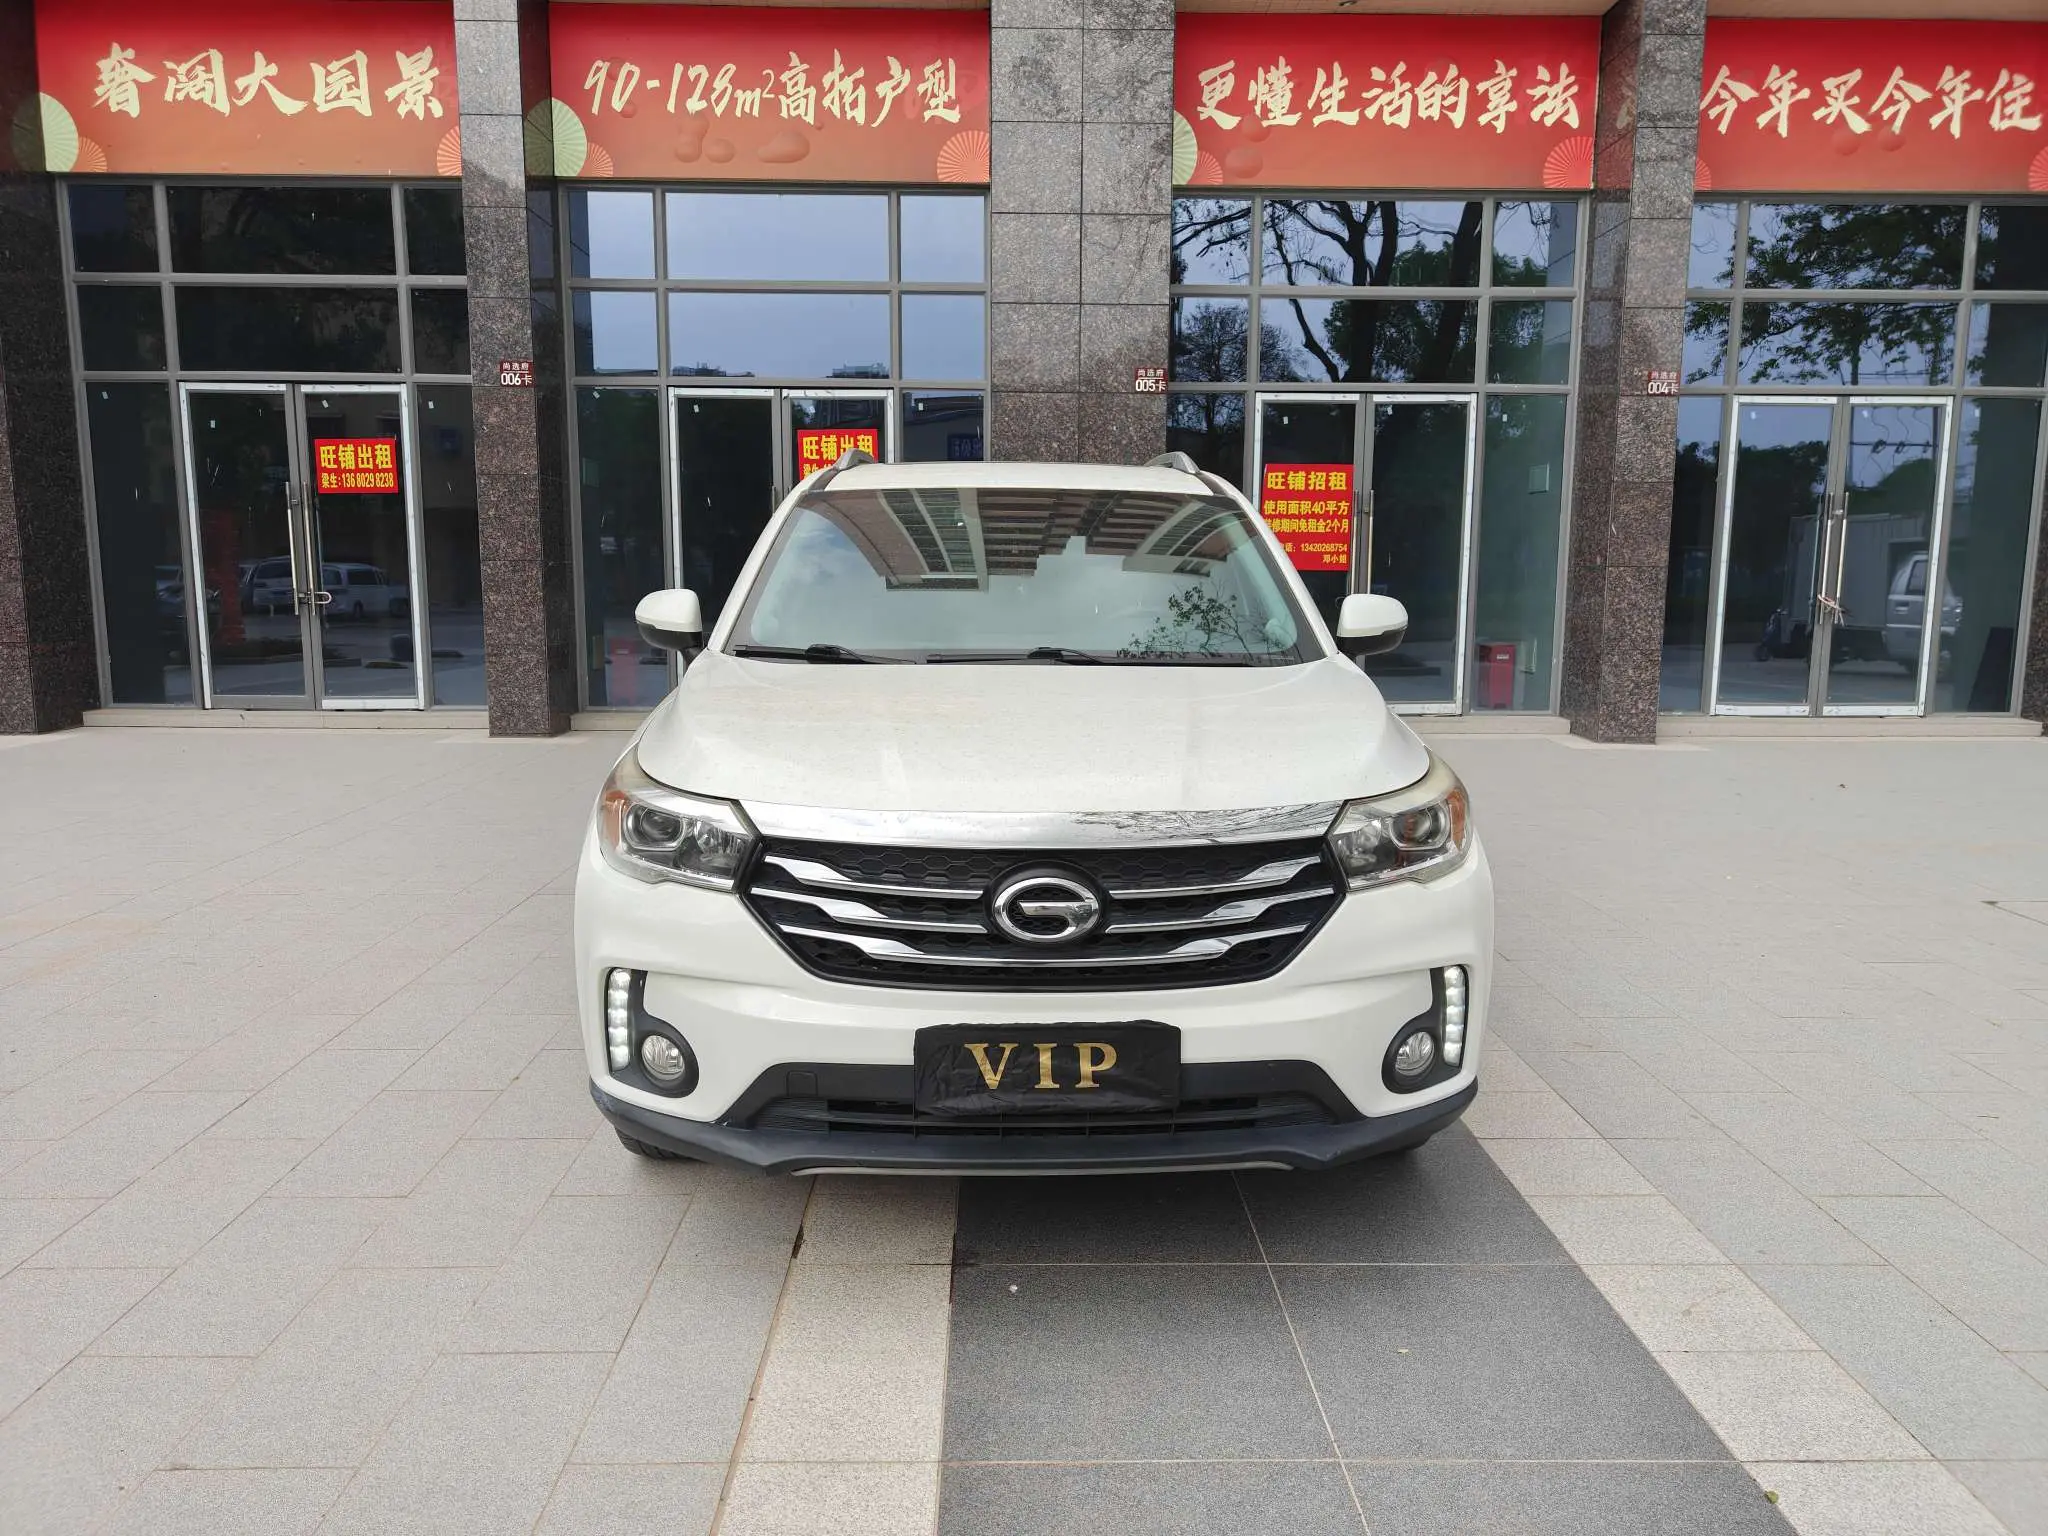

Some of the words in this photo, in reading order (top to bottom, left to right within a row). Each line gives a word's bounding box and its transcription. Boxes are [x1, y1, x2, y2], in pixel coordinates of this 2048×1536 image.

[1196, 56, 1579, 134] 更懂生活的享法
[1700, 64, 2042, 139] 今年买今年住
[501, 373, 532, 386] 006卡
[1136, 379, 1166, 392] 005卡
[1648, 381, 1679, 394] 004卡
[320, 443, 393, 470] 旺铺出租
[1267, 471, 1347, 491] 旺铺招租
[1264, 500, 1349, 515] 使用面积40平方
[963, 1042, 1118, 1090] VIP
